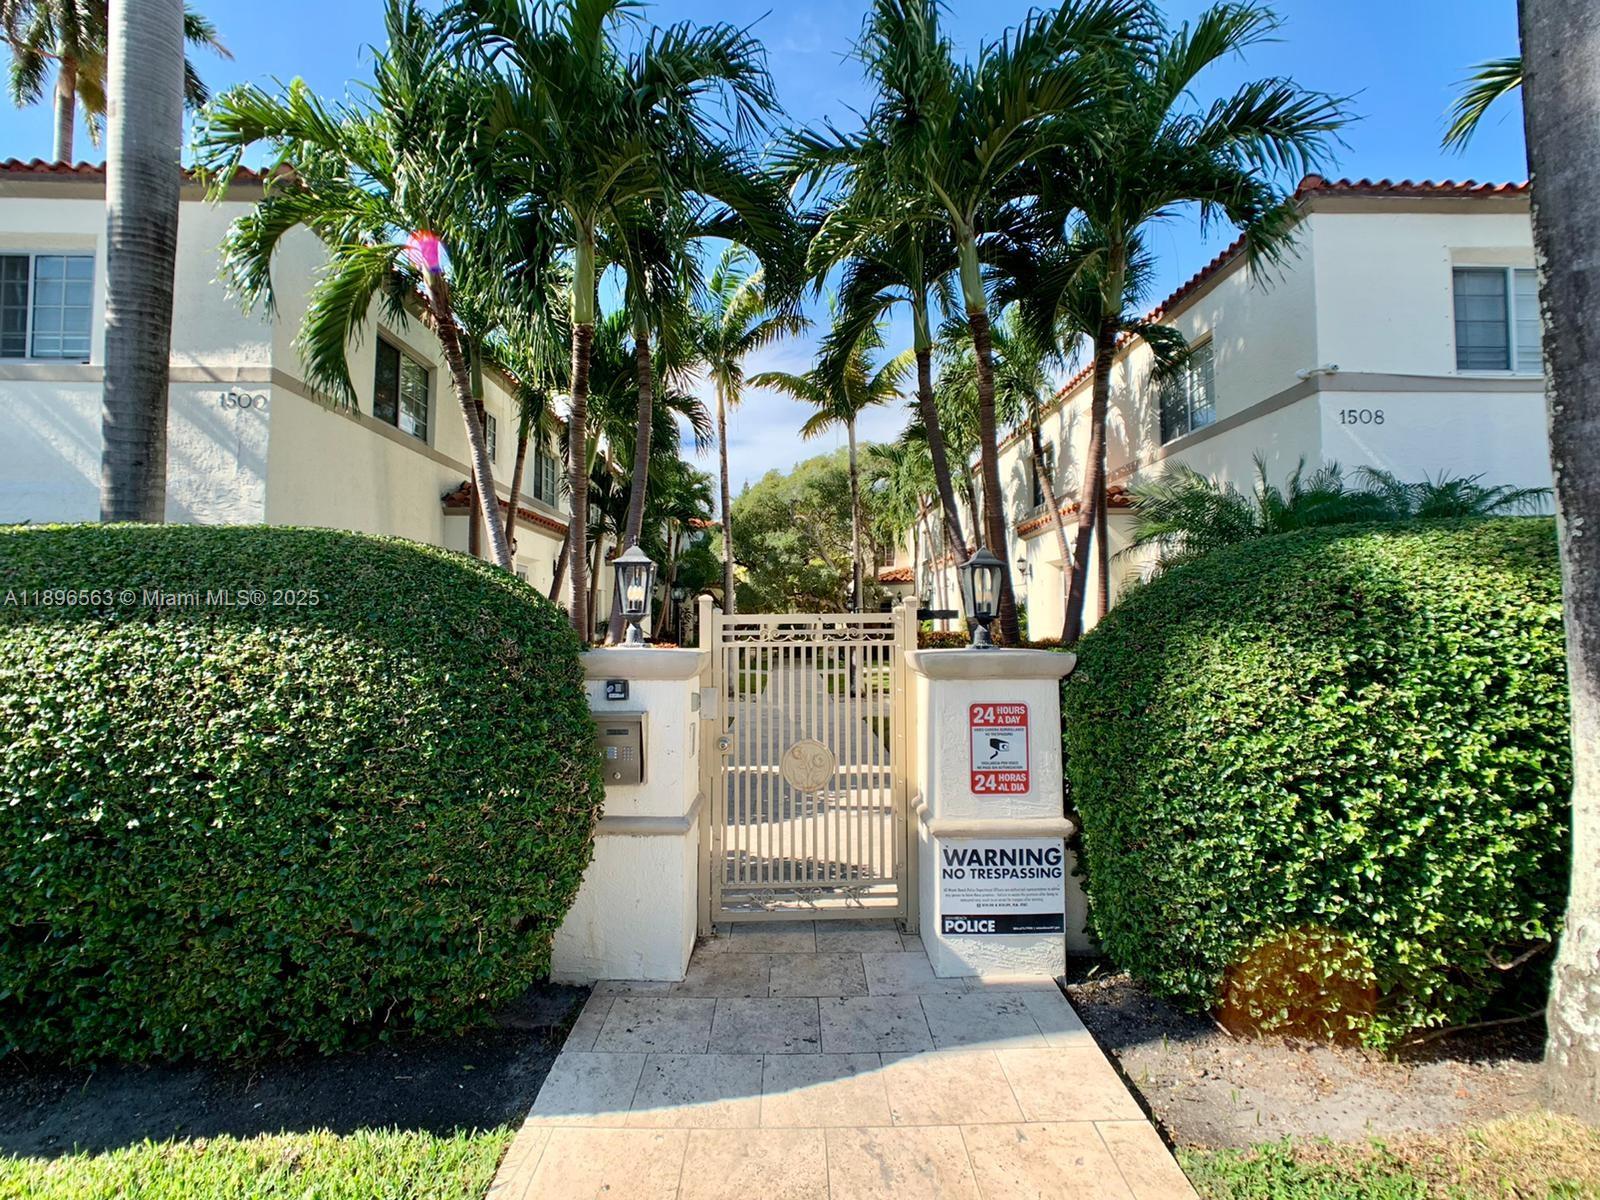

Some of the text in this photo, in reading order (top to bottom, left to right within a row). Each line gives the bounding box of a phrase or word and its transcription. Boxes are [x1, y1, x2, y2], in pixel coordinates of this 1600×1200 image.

[1339, 409, 1385, 425] 1508
[973, 707, 995, 724] 24
[997, 706, 1026, 714] HOURS
[998, 716, 1021, 724] A DAY
[974, 774, 997, 791] 24
[998, 774, 1026, 782] HORAS
[999, 783, 1025, 791] AL DIA
[943, 847, 1062, 867] WARNING
[942, 867, 1062, 880] NO TRESPASSING
[944, 920, 996, 933] POLICE
